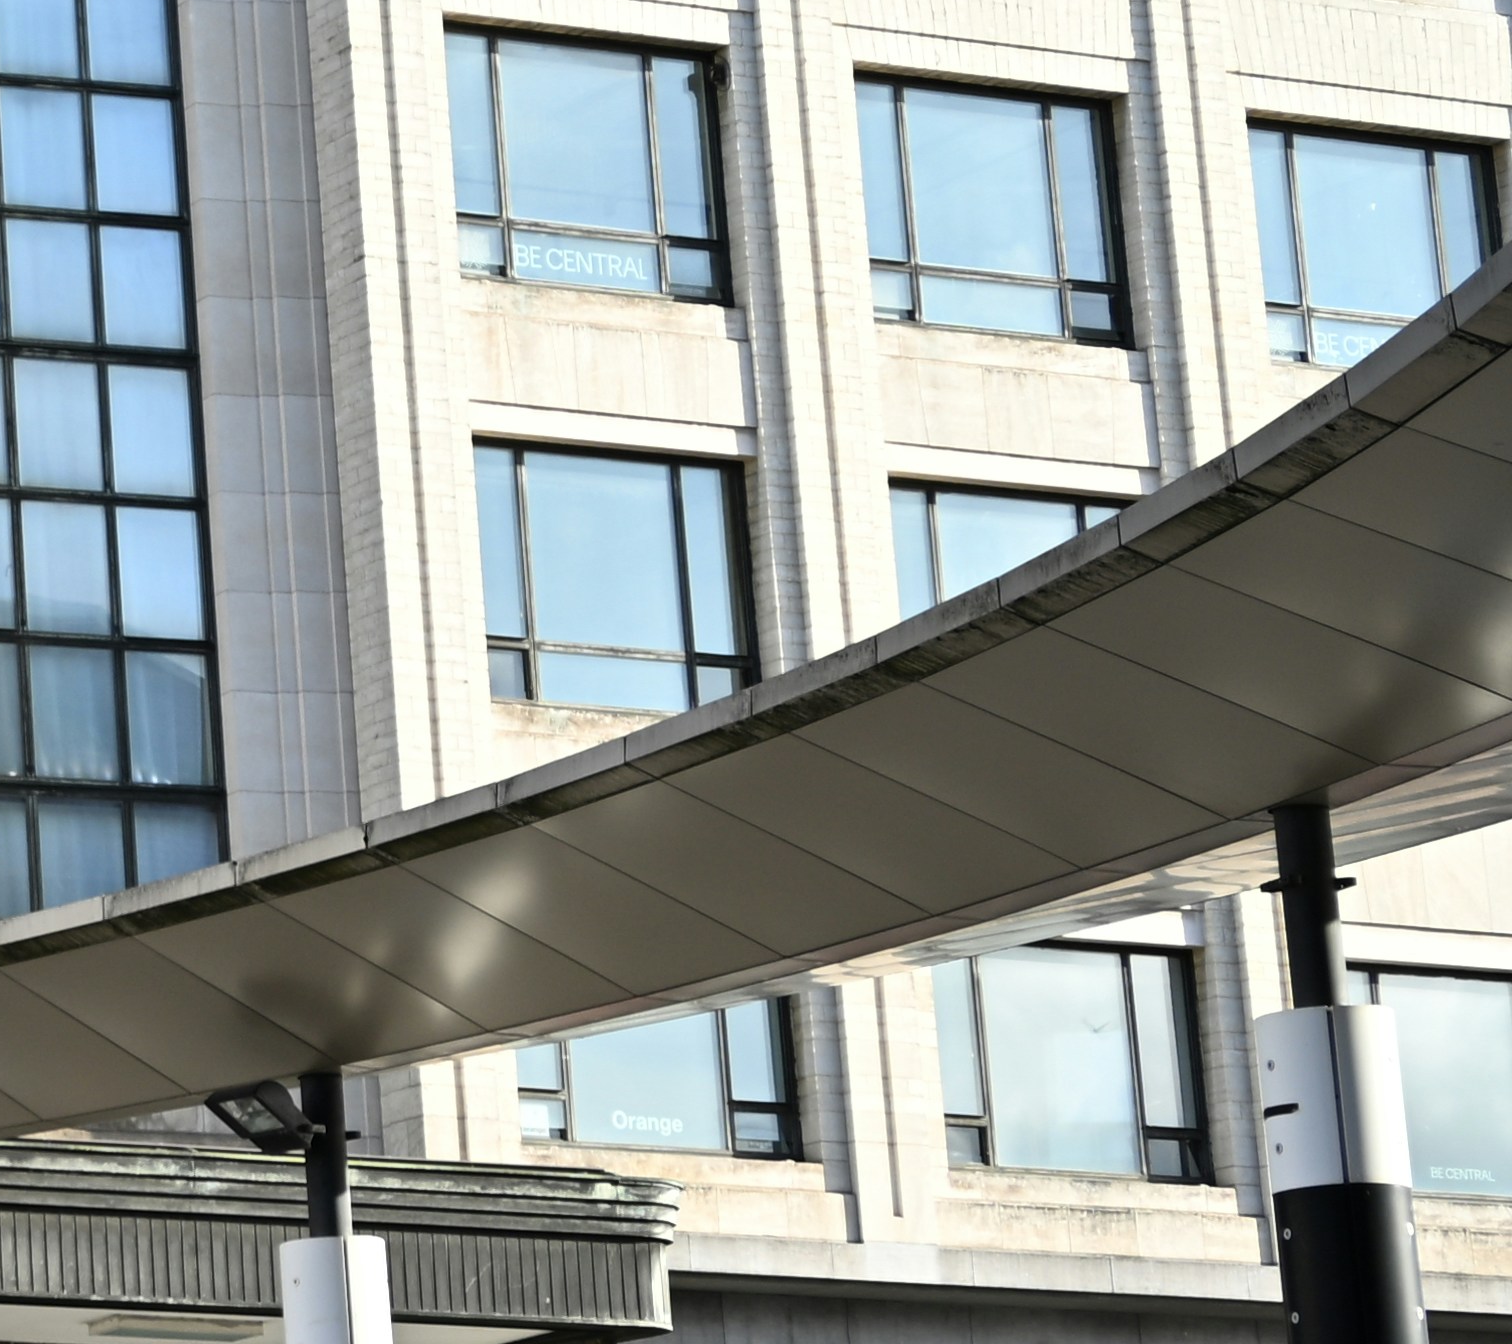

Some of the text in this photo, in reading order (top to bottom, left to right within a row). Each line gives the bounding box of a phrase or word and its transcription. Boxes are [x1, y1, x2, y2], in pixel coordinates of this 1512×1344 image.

[515, 243, 648, 280] BE CENTRAL
[612, 1110, 683, 1136] Orange
[1445, 1167, 1496, 1182] CENTRAL
